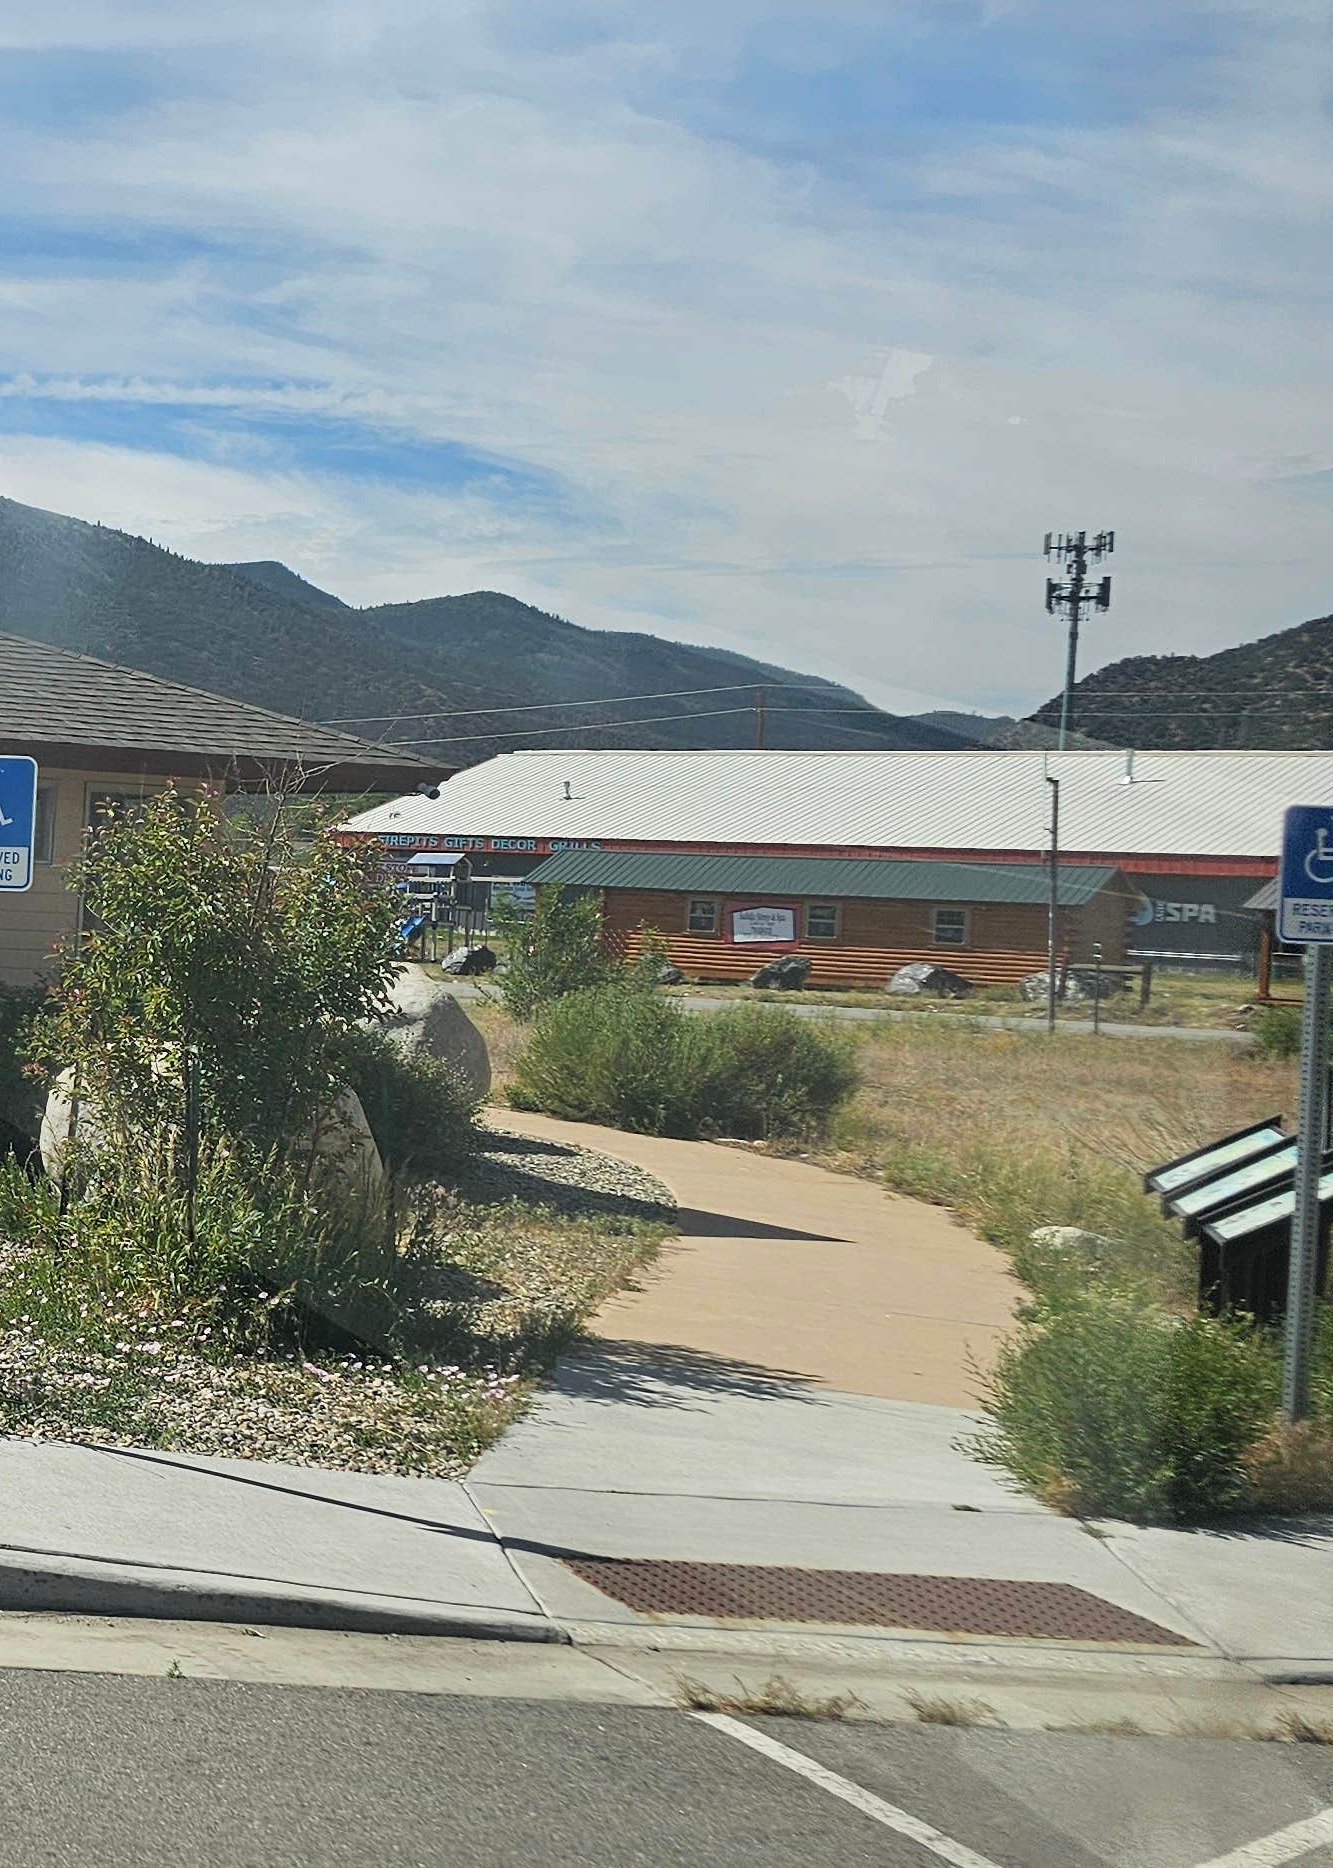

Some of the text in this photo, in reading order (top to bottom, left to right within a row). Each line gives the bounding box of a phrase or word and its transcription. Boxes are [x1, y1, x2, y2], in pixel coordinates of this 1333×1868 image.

[444, 836, 485, 850] GIFTS
[491, 838, 537, 851] DECOR
[1166, 903, 1216, 923] SPA
